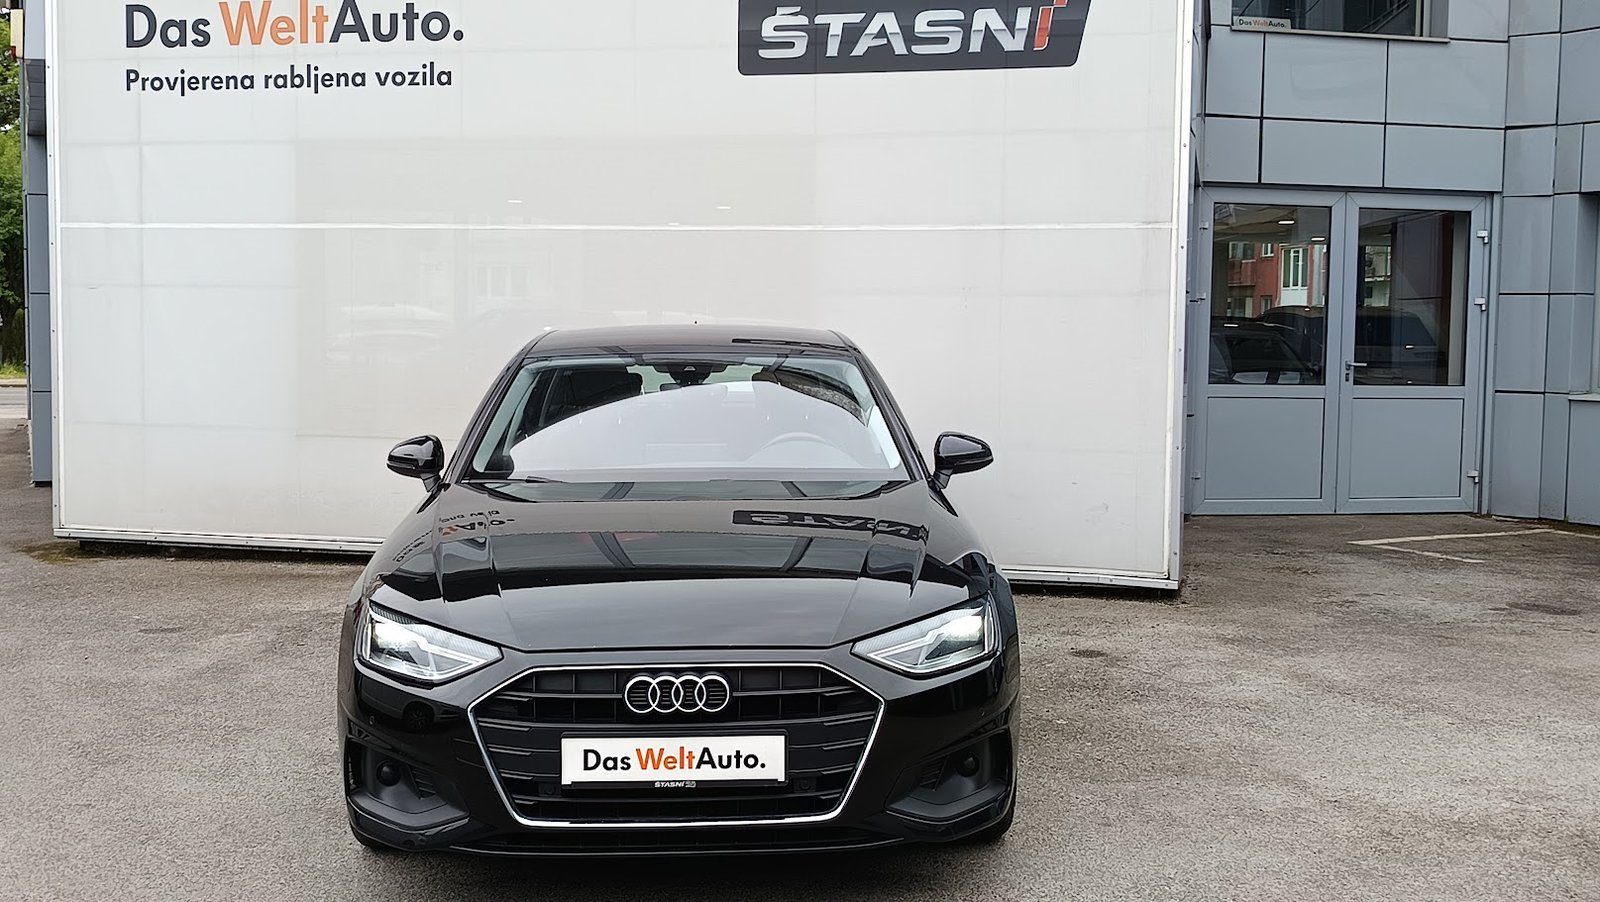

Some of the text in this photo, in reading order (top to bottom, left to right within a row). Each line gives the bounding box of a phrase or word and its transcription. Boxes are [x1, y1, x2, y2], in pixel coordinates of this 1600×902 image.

[125, 0, 464, 49] Das WeltAuto.
[1238, 18, 1252, 26] Das
[125, 62, 452, 97] Provjerena rabljena vozila
[583, 746, 766, 771] Das WeltAuto.
